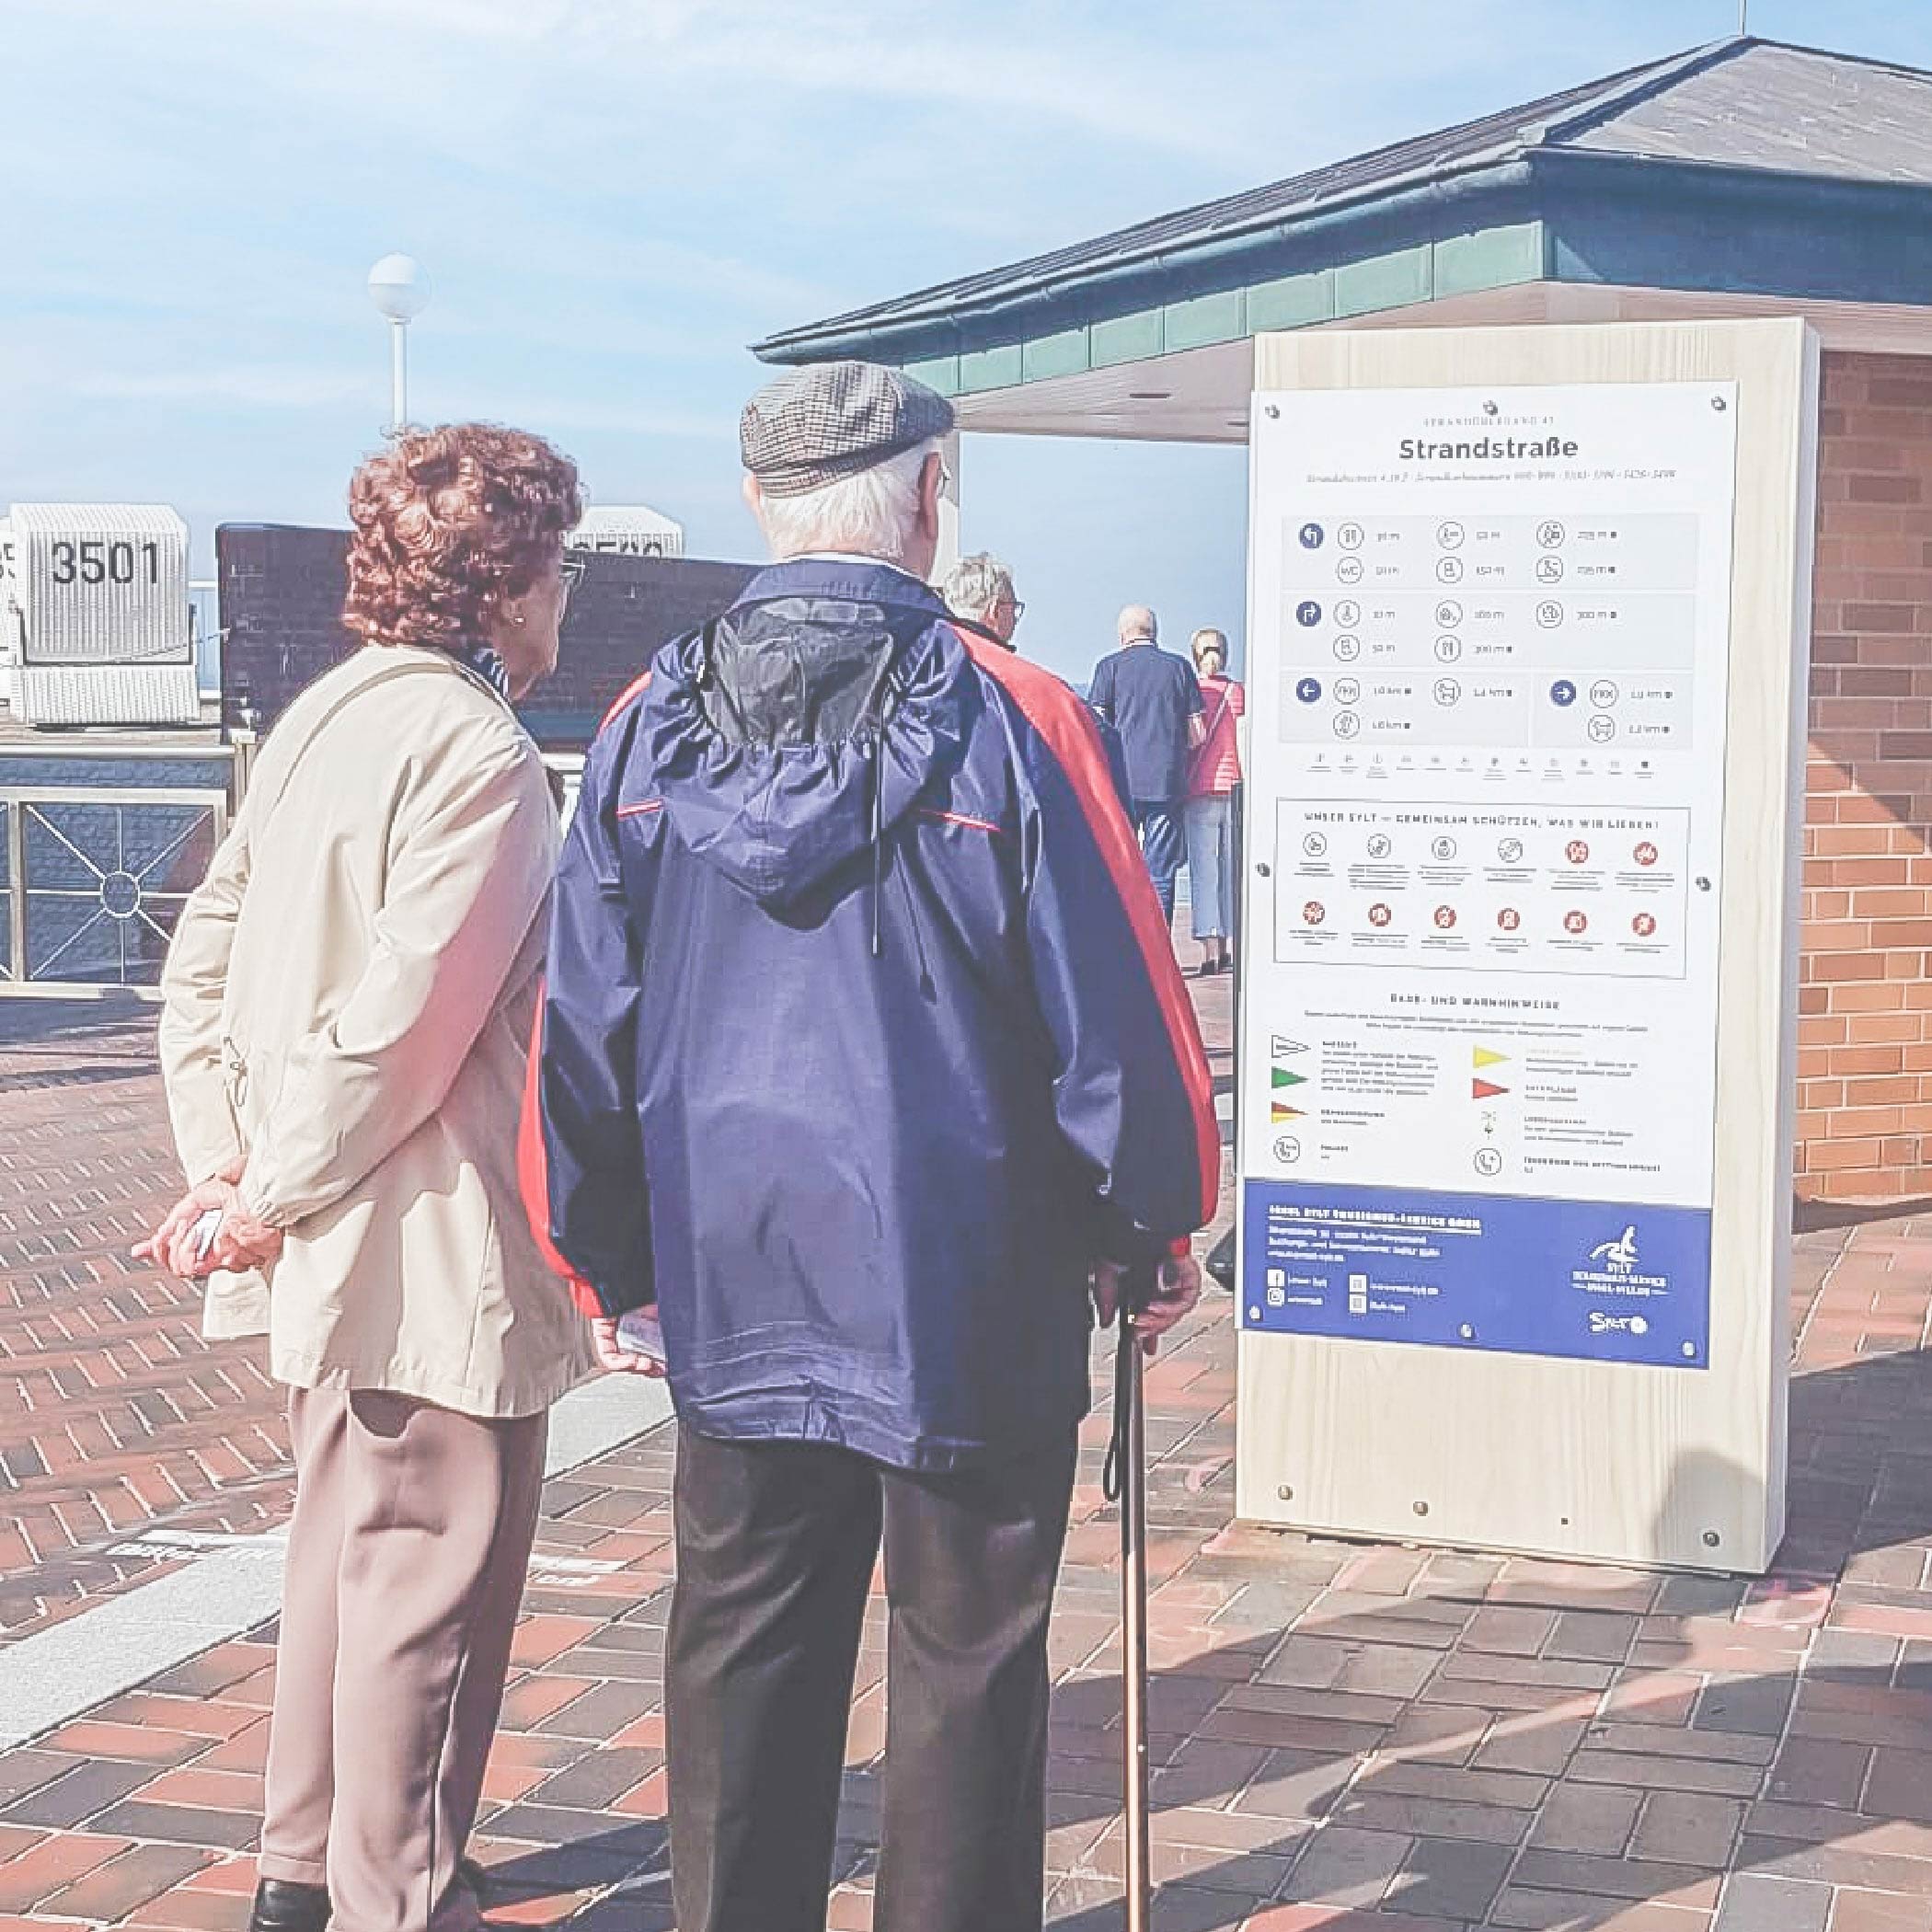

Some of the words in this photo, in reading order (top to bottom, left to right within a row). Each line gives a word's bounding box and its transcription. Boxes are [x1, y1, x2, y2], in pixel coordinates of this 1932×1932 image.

[1398, 436, 1578, 459] Strandstraße
[52, 541, 157, 584] 3501
[1340, 566, 1359, 576] WC
